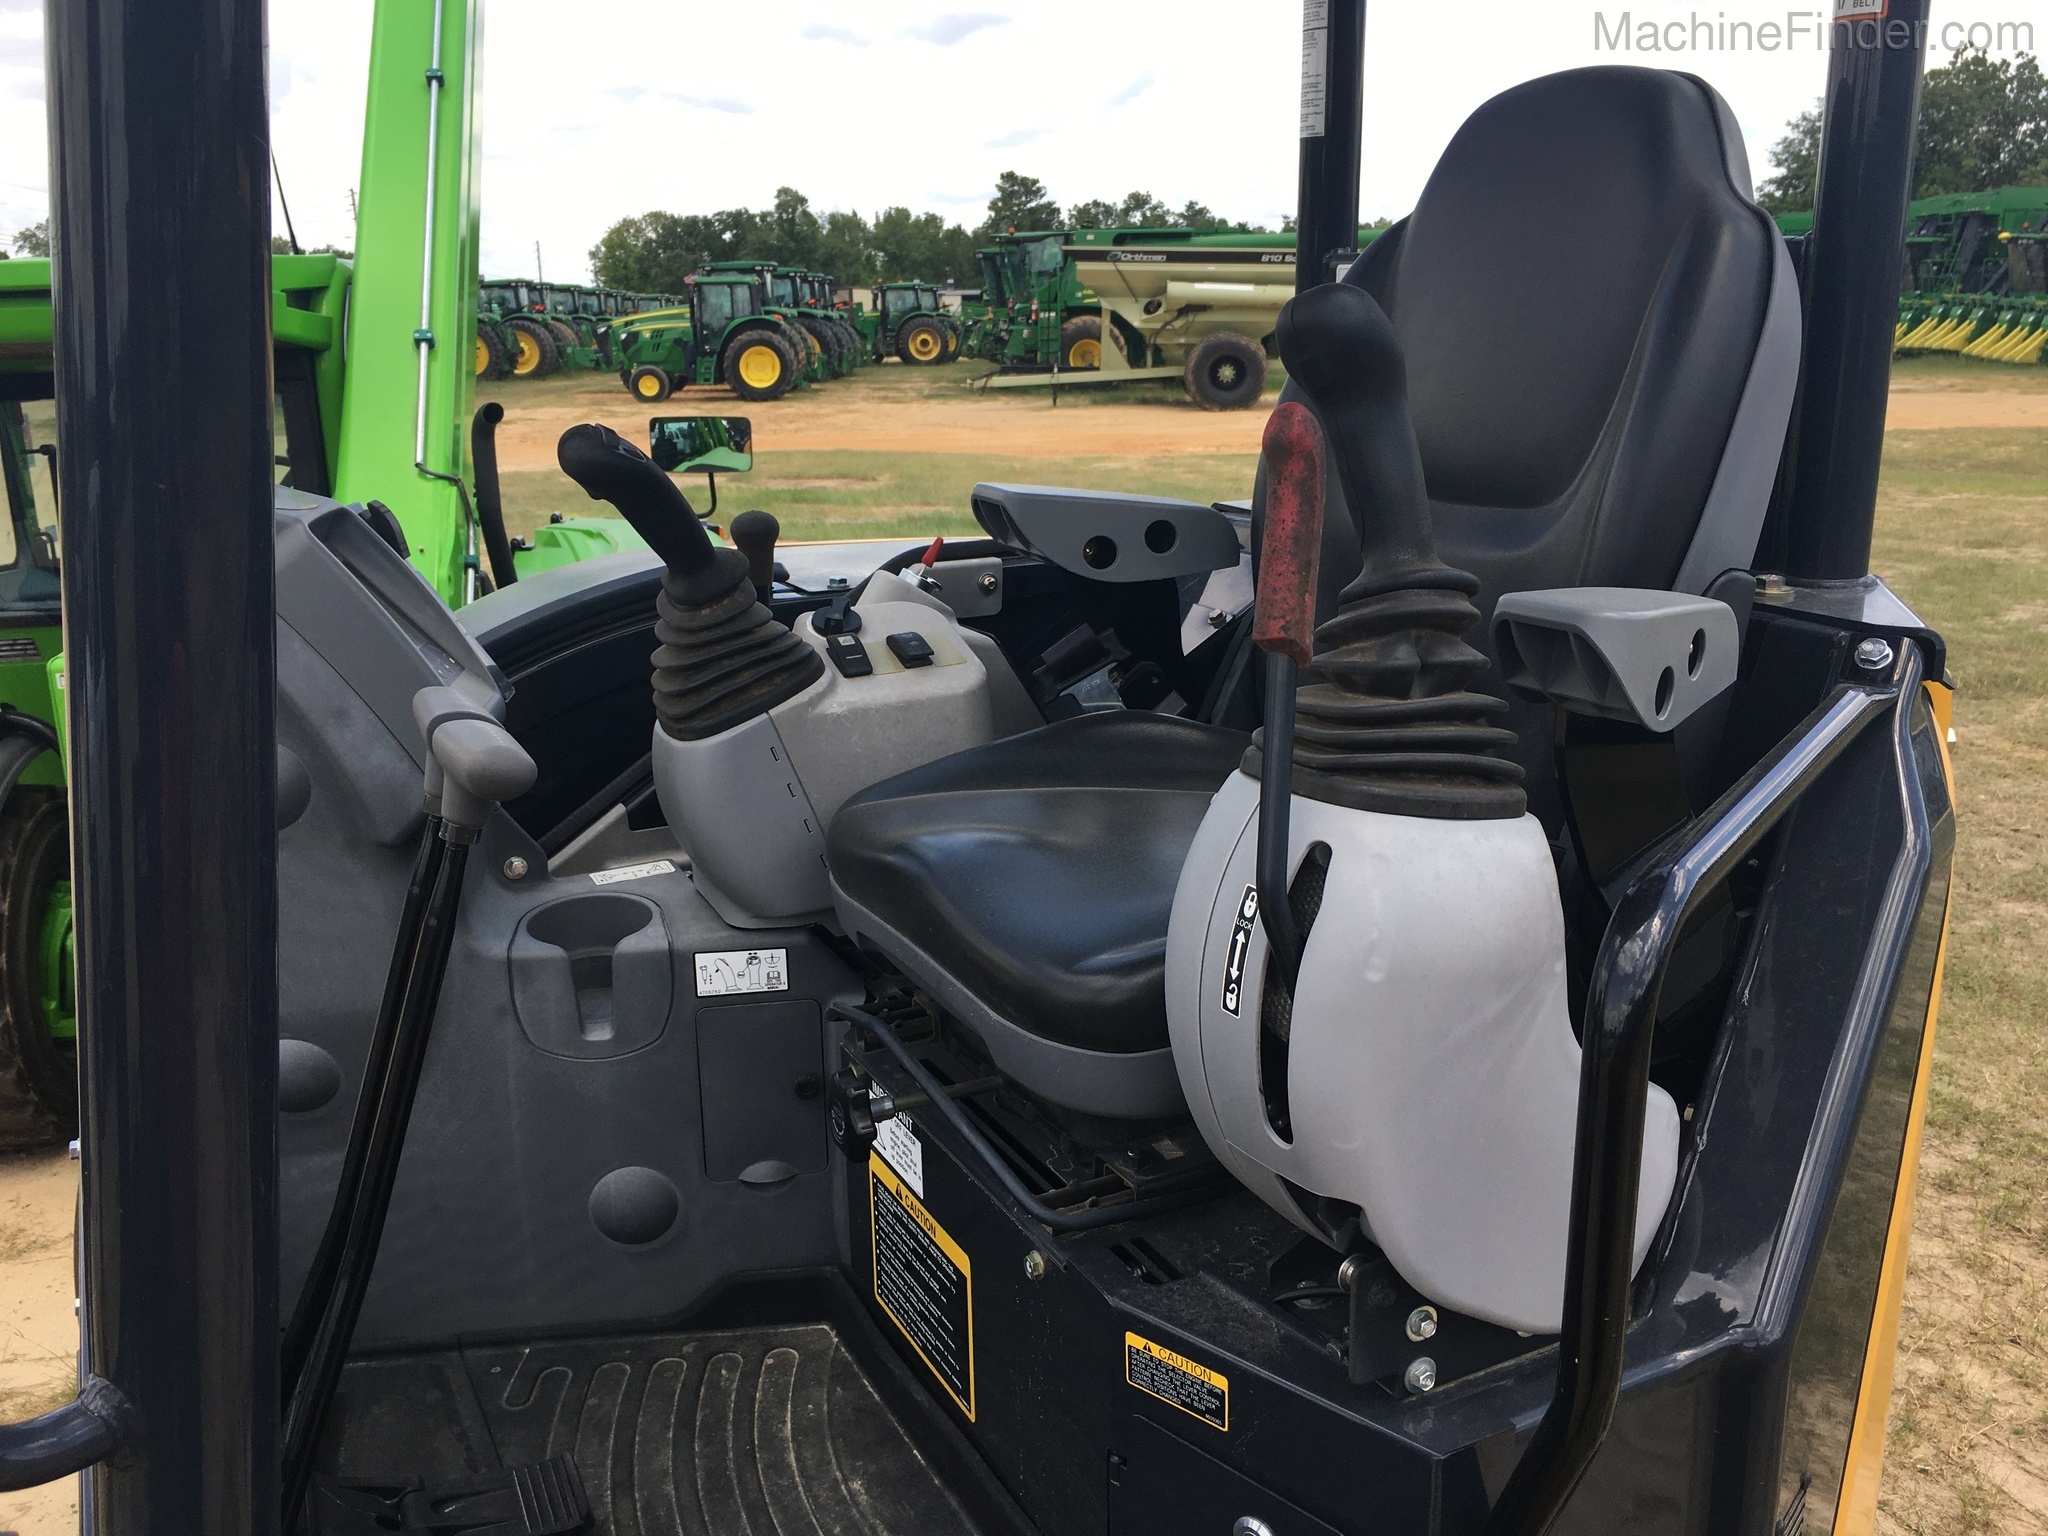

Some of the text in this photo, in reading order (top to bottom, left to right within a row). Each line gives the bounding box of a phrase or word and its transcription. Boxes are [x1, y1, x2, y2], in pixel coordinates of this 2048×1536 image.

[1120, 253, 1167, 262] Orthman
[1236, 917, 1252, 930] LOCK
[904, 1194, 937, 1239] CAUTION
[1158, 1348, 1212, 1382] CAUTION
